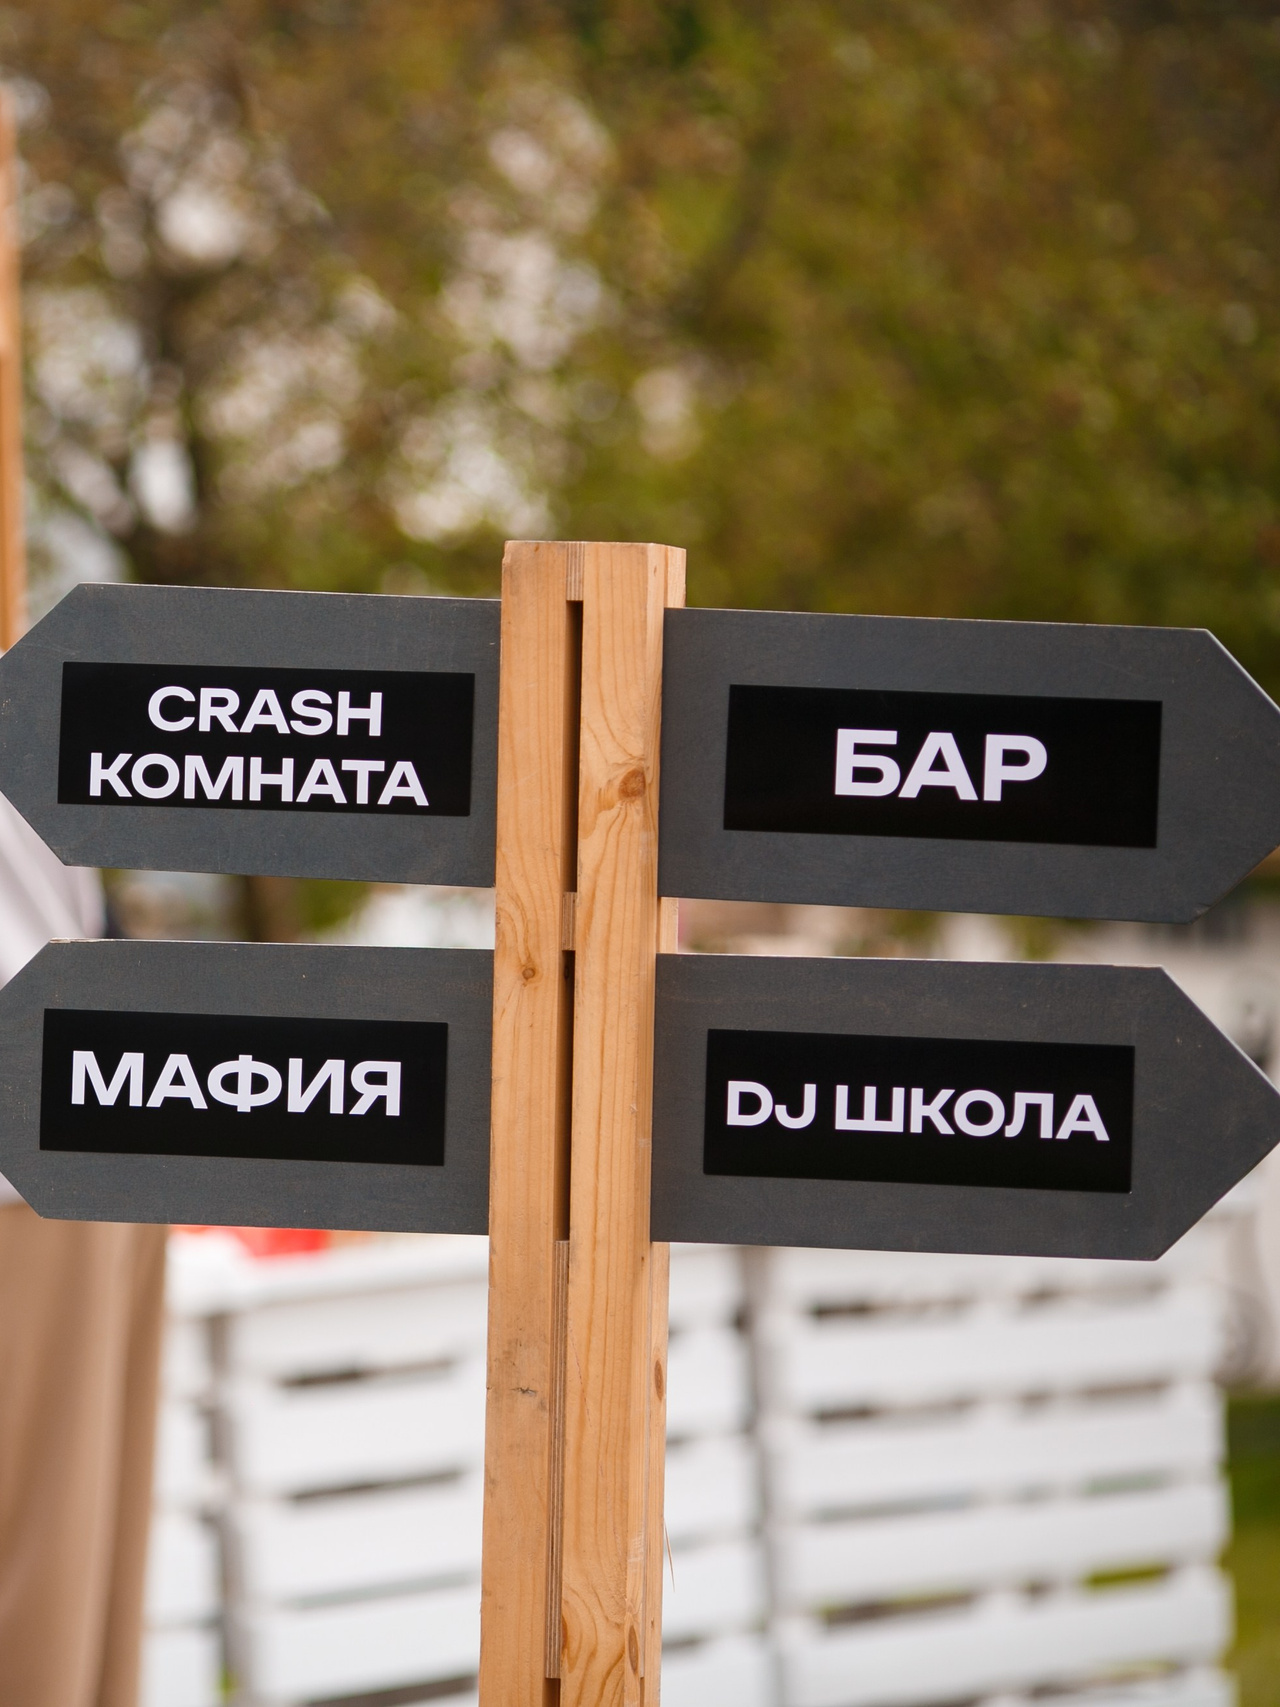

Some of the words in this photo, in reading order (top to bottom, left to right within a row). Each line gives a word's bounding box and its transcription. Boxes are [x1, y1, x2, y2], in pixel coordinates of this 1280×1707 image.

[148, 685, 384, 737] CRASH
[88, 752, 429, 807] КОМНАТА
[834, 728, 1048, 802] БАР
[71, 1050, 403, 1117] МАФИЯ
[726, 1080, 817, 1129] DJ
[835, 1085, 1110, 1142] ШКОЛА
